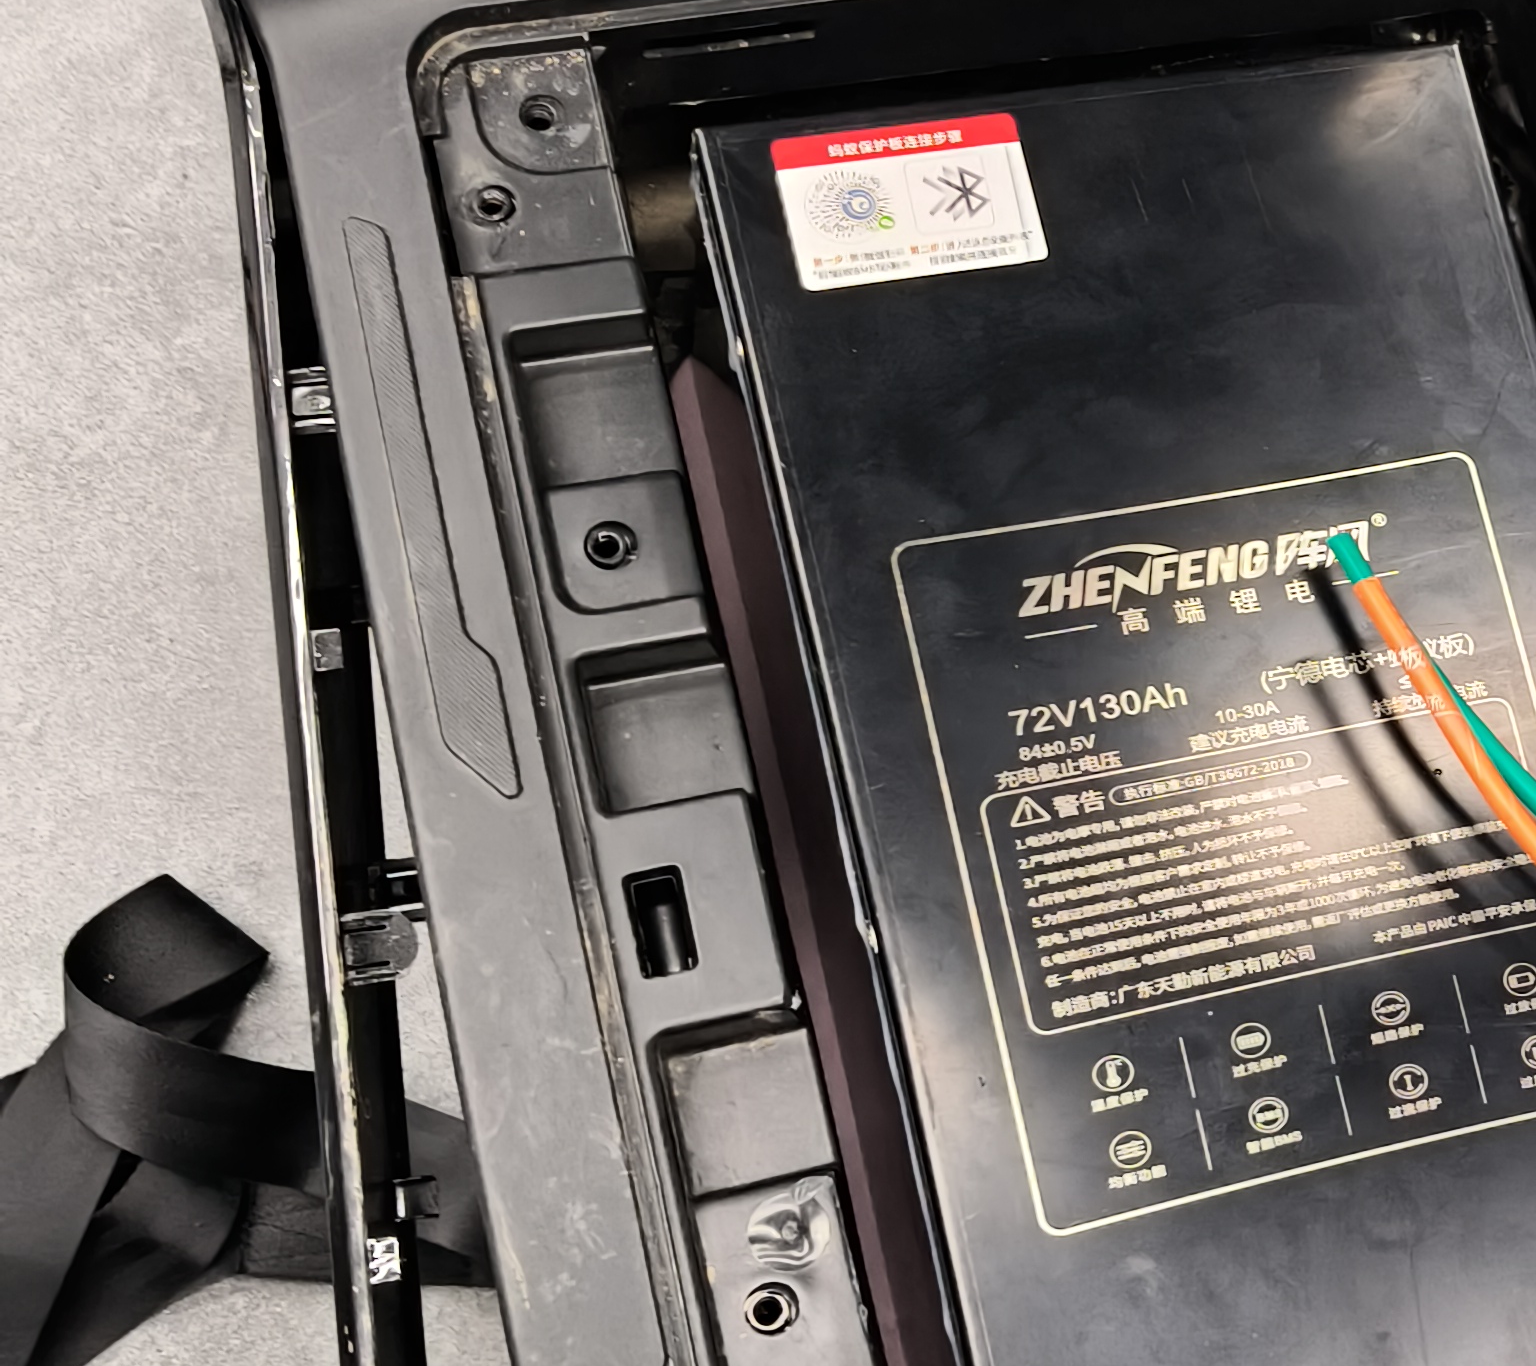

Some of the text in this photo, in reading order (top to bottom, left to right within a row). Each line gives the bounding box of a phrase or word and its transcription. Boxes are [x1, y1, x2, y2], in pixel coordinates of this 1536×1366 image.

[1018, 540, 1268, 618] ZHENFENG
[1120, 580, 1315, 636] 高端锂电
[1008, 683, 1187, 737] 72V130Ah
[1214, 700, 1280, 724] 10-30A
[1018, 734, 1096, 762] 84±0.5V
[1188, 715, 1309, 753] 建议充电电流
[995, 750, 1122, 789] 充电截止电压
[1051, 789, 1105, 818] 警告
